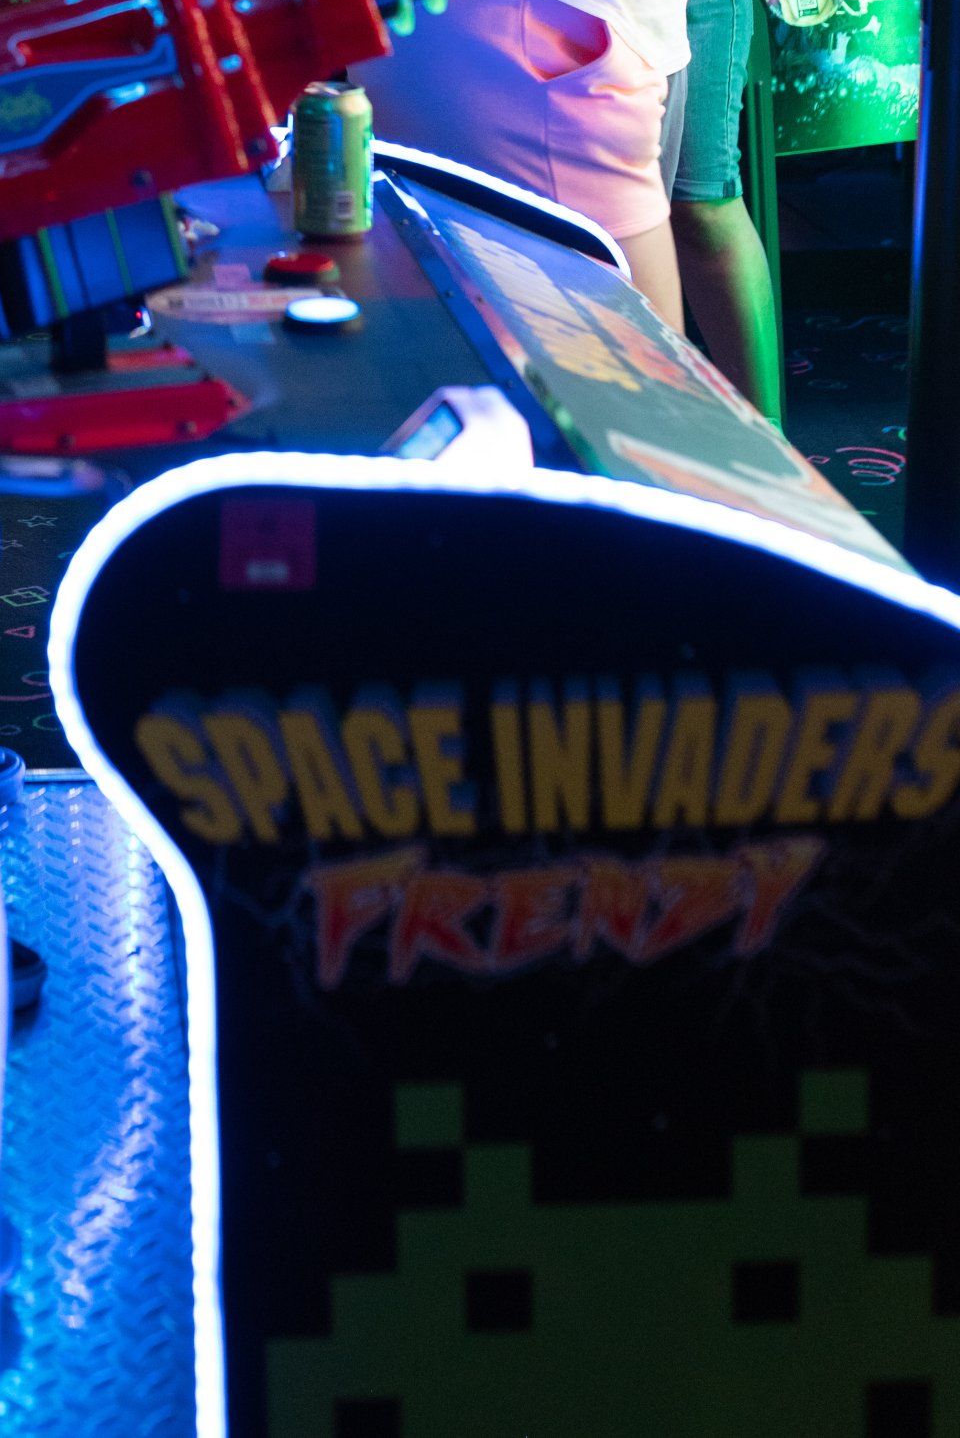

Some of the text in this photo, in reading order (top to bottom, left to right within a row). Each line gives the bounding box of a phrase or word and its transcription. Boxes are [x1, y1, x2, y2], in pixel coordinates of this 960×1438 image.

[135, 687, 960, 845] SPACE INVADERS
[306, 838, 828, 990] FRENZY
